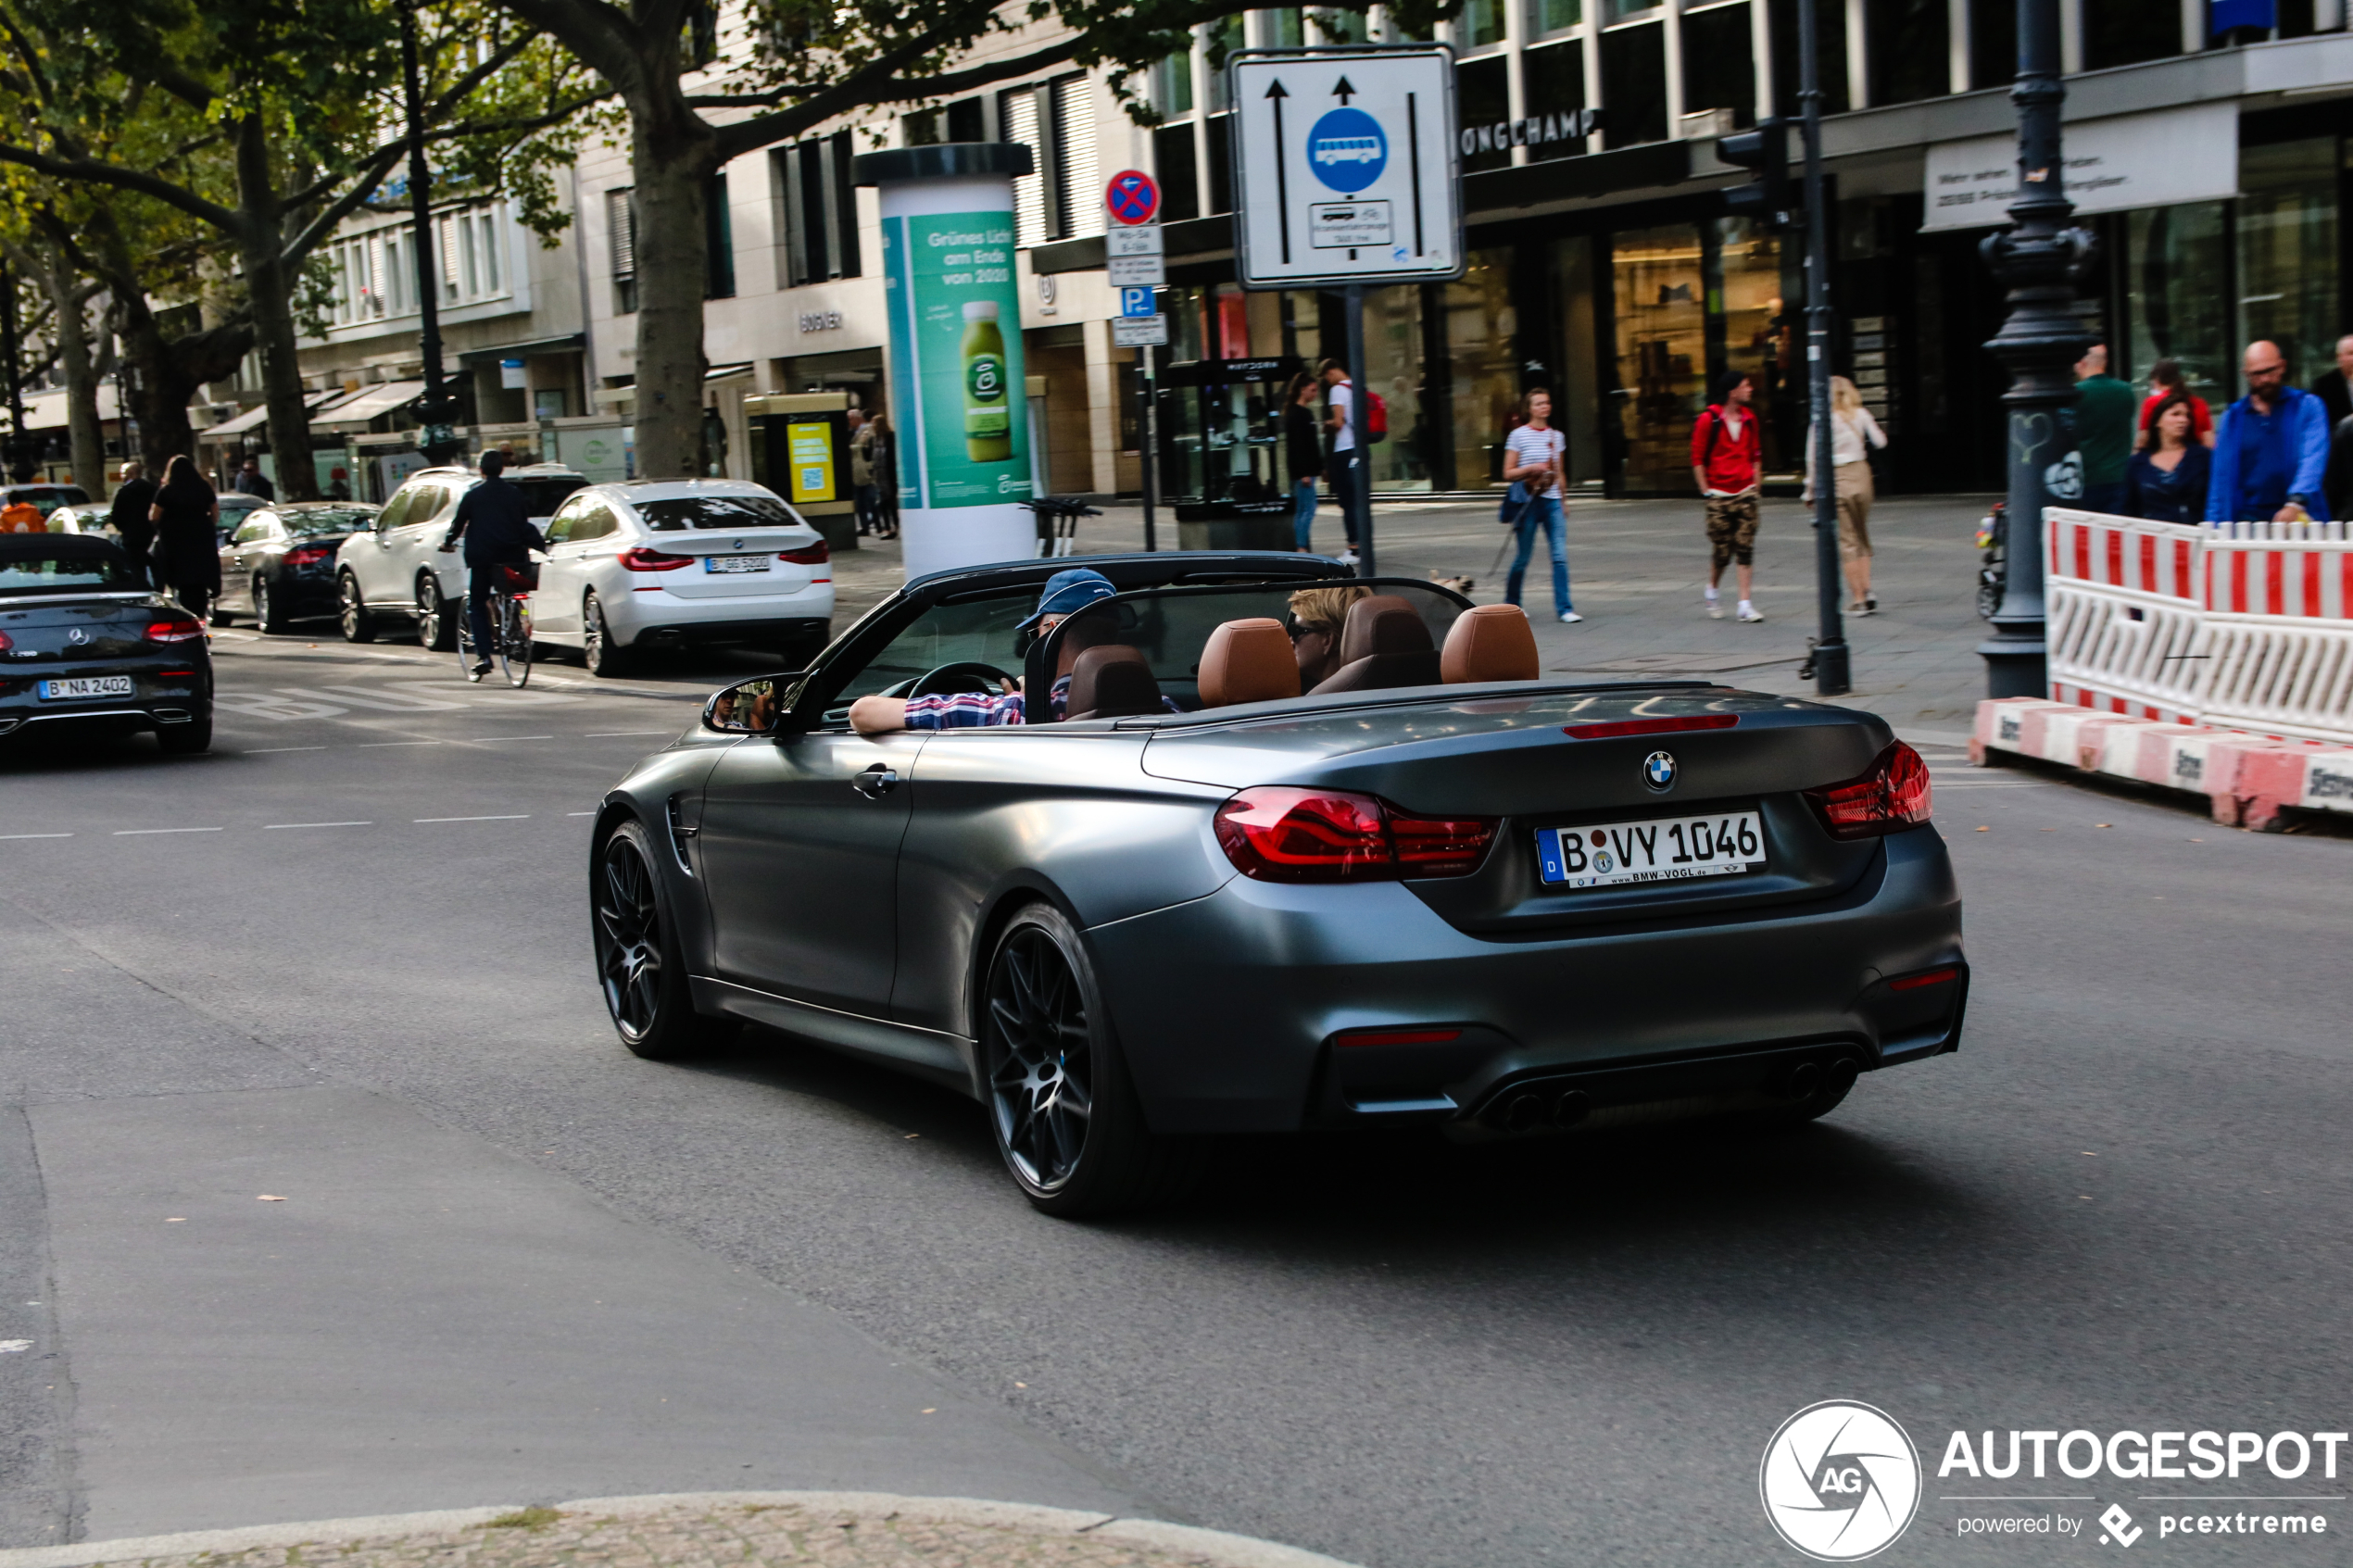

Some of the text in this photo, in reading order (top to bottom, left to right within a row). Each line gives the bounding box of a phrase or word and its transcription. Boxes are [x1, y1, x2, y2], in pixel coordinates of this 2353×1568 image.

[1461, 109, 1595, 156] ONGCHAMP
[927, 231, 985, 247] Grünes
[943, 248, 1006, 266] am Ende
[942, 268, 1010, 285] von 2020
[49, 678, 129, 696] B NA 2402
[1560, 817, 1758, 873] B VY 1046
[1547, 860, 1556, 873] D
